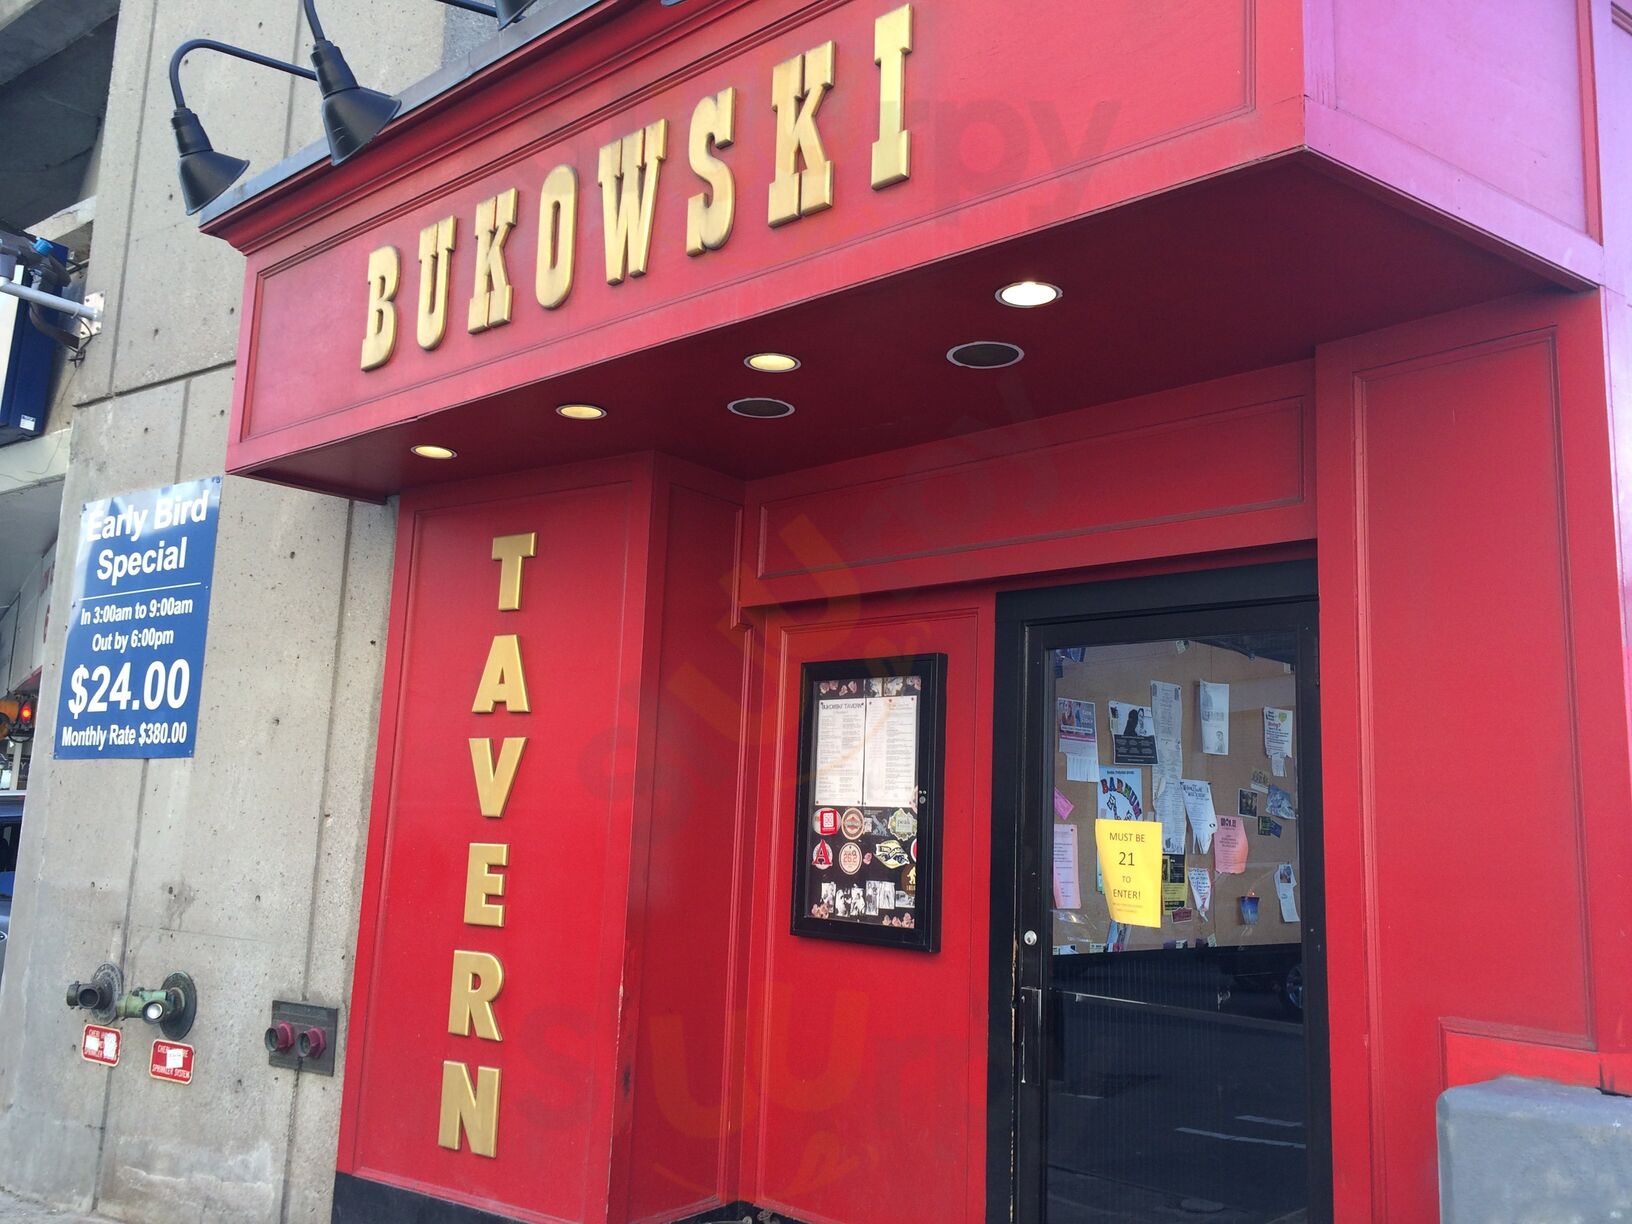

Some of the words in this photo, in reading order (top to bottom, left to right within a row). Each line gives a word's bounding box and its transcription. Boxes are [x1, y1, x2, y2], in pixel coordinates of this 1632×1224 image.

[360, 4, 913, 371] BUKOWSKI
[87, 504, 148, 542] Early
[153, 490, 209, 529] Bird
[97, 537, 188, 586] Special
[80, 608, 91, 625] In
[93, 604, 132, 624] 3:00am
[135, 602, 147, 619] to
[149, 597, 193, 617] 9:00am
[92, 633, 112, 651] Out
[114, 632, 128, 653] by
[131, 628, 174, 649] 6:00pm
[68, 658, 190, 720] $24.00
[62, 725, 107, 751] Monthly
[109, 724, 136, 745] Rate
[139, 721, 187, 746] $380.00
[438, 532, 537, 1159] TAVERN
[1109, 832, 1133, 842] MUST
[1135, 833, 1145, 843] BE
[1118, 851, 1135, 867] 21
[1113, 888, 1141, 900] ENTER!
[1122, 875, 1131, 884] TO
